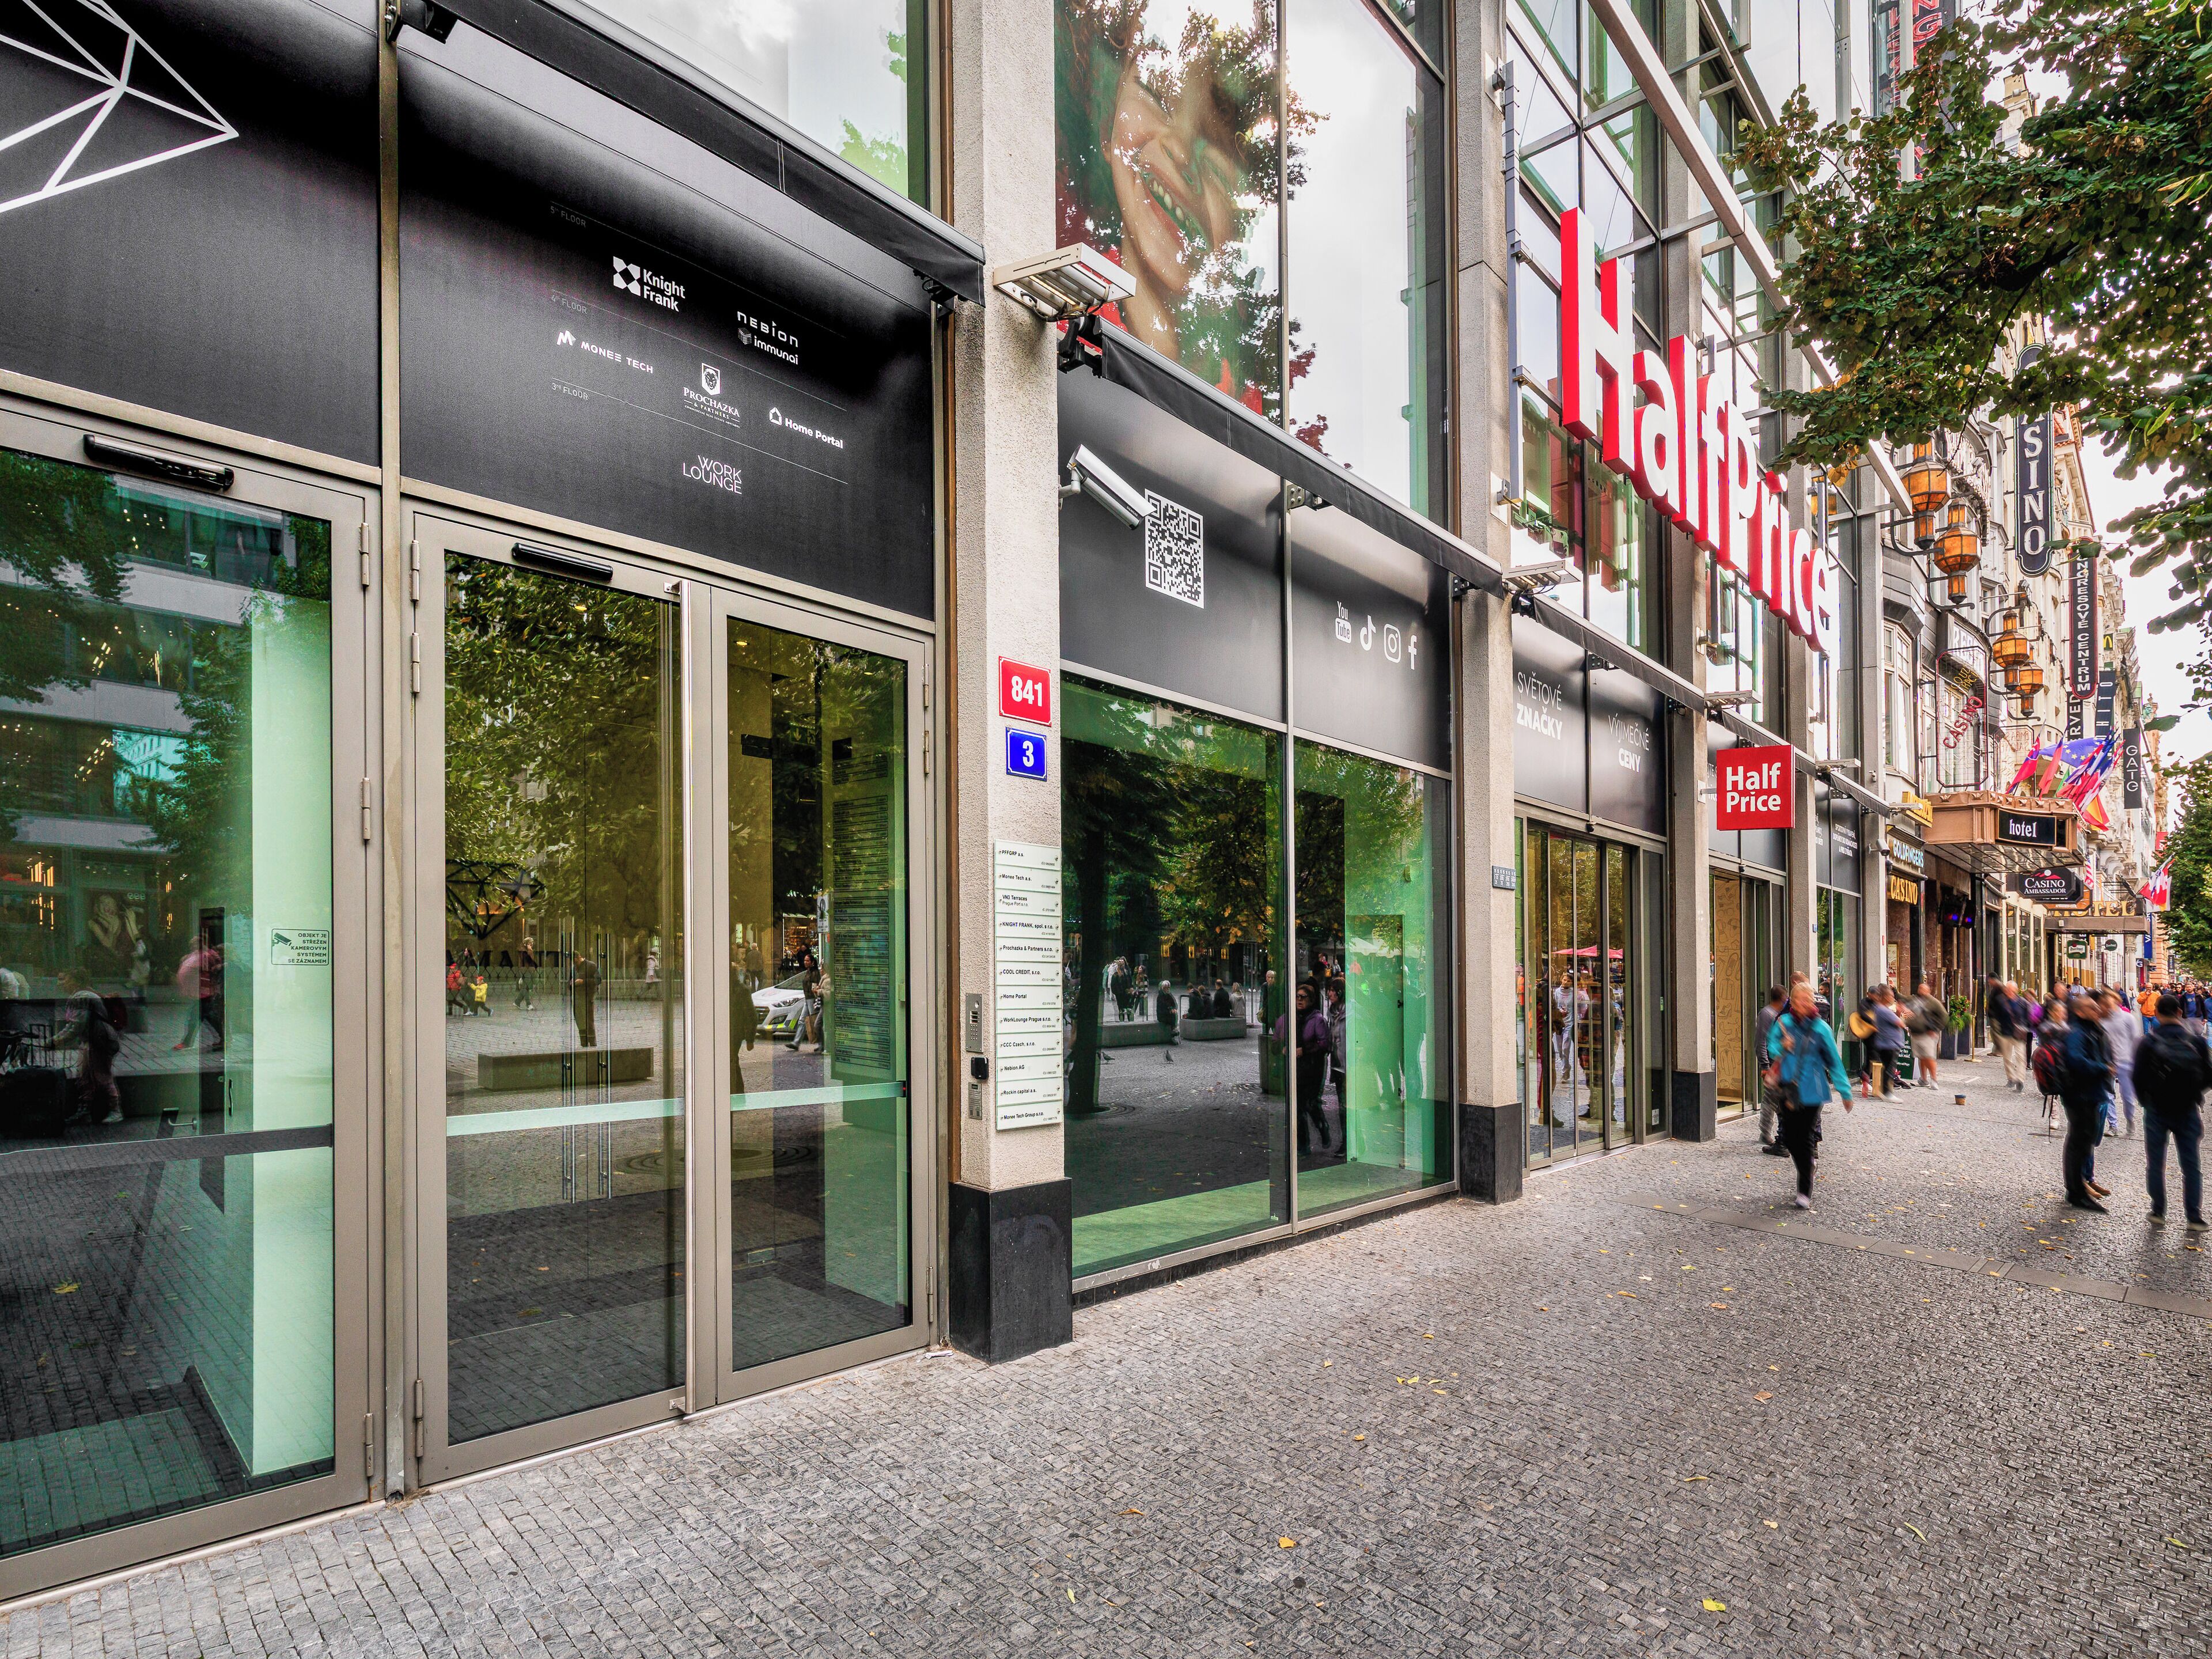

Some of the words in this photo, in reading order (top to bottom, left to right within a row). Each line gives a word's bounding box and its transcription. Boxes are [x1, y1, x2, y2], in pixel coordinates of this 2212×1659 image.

[561, 210, 586, 228] FLOOR
[643, 268, 685, 299] Knight
[643, 285, 679, 312] Frank
[562, 298, 587, 314] FLOOR
[581, 341, 622, 362] MONEE
[626, 357, 653, 373] TECH
[753, 335, 798, 365] immunai
[563, 386, 589, 400] FLOOR
[683, 387, 740, 418] PROCHAZKA
[684, 405, 705, 415] COMMERCIAL
[700, 404, 729, 419] PARTNERS
[785, 417, 813, 437] Home
[815, 430, 843, 449] Portal
[698, 454, 742, 484] WORK
[2023, 361, 2046, 555] SINO
[683, 462, 742, 494] LOUNGE
[1337, 601, 1349, 620] You
[1337, 621, 1350, 640] Tube
[2077, 633, 2090, 690] CENTRUM
[1011, 675, 1042, 707] 841
[1517, 671, 1562, 711] SVĚTOVÉ
[1516, 703, 1563, 740] ZNAČKY
[1608, 713, 1649, 751] VÝJIMEČNÉ
[1943, 696, 1982, 749] CASINO
[1022, 740, 1035, 767] 3
[1618, 748, 1641, 772] CENY
[1726, 762, 1781, 791] Half
[1726, 791, 1781, 813] Price
[2009, 819, 2037, 838] hotel
[1893, 839, 1924, 868] GOLDFINGERS
[1891, 875, 1918, 905] CASINO
